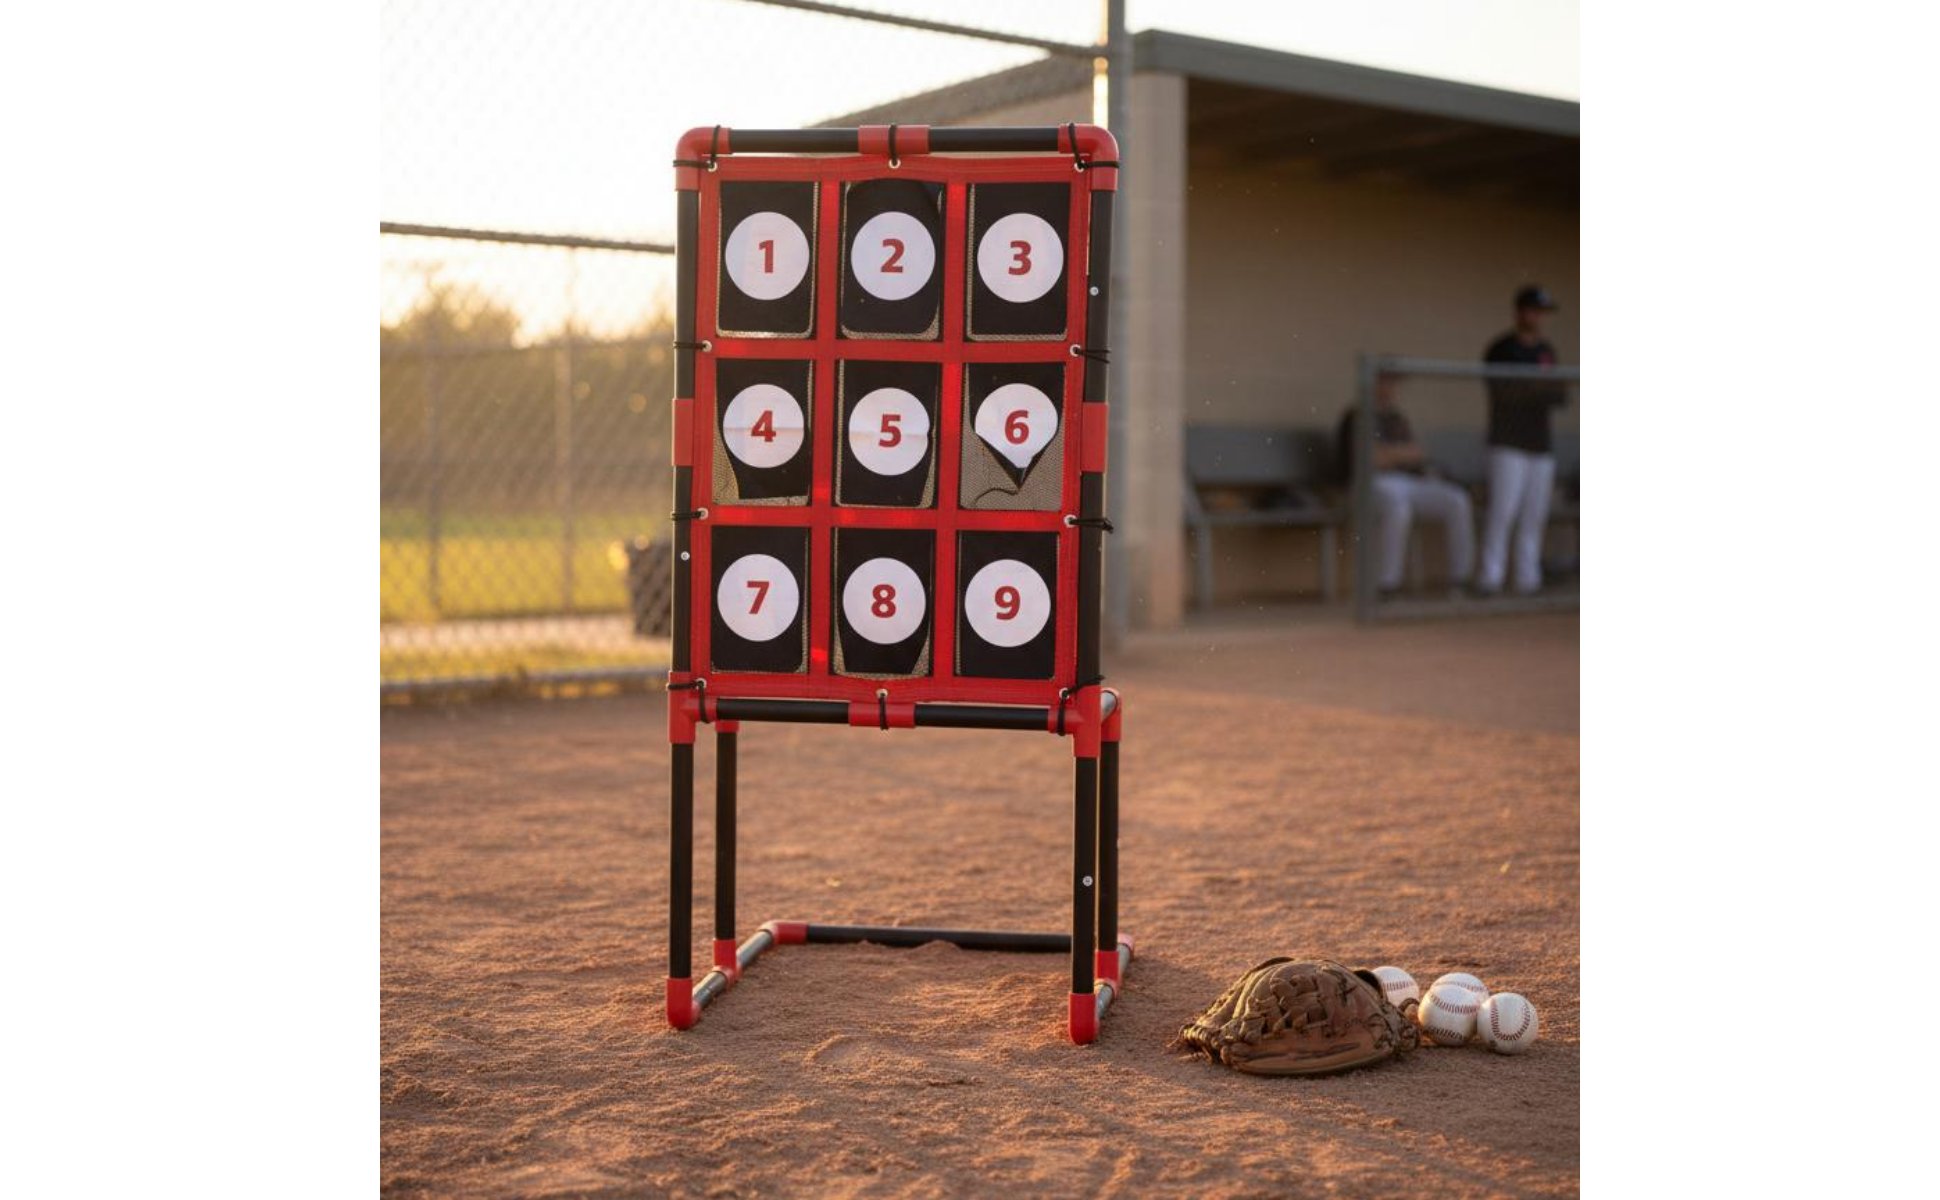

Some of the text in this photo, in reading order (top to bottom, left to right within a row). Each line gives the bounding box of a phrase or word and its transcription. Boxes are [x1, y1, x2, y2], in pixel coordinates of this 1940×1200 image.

[758, 240, 773, 273] 1
[882, 240, 904, 273] 2
[1008, 241, 1032, 275] 3
[751, 409, 778, 442] 4
[879, 413, 903, 448] 5
[1004, 410, 1030, 444] 6
[746, 580, 771, 614] 7
[871, 583, 898, 619] 8
[994, 585, 1021, 620] 9
